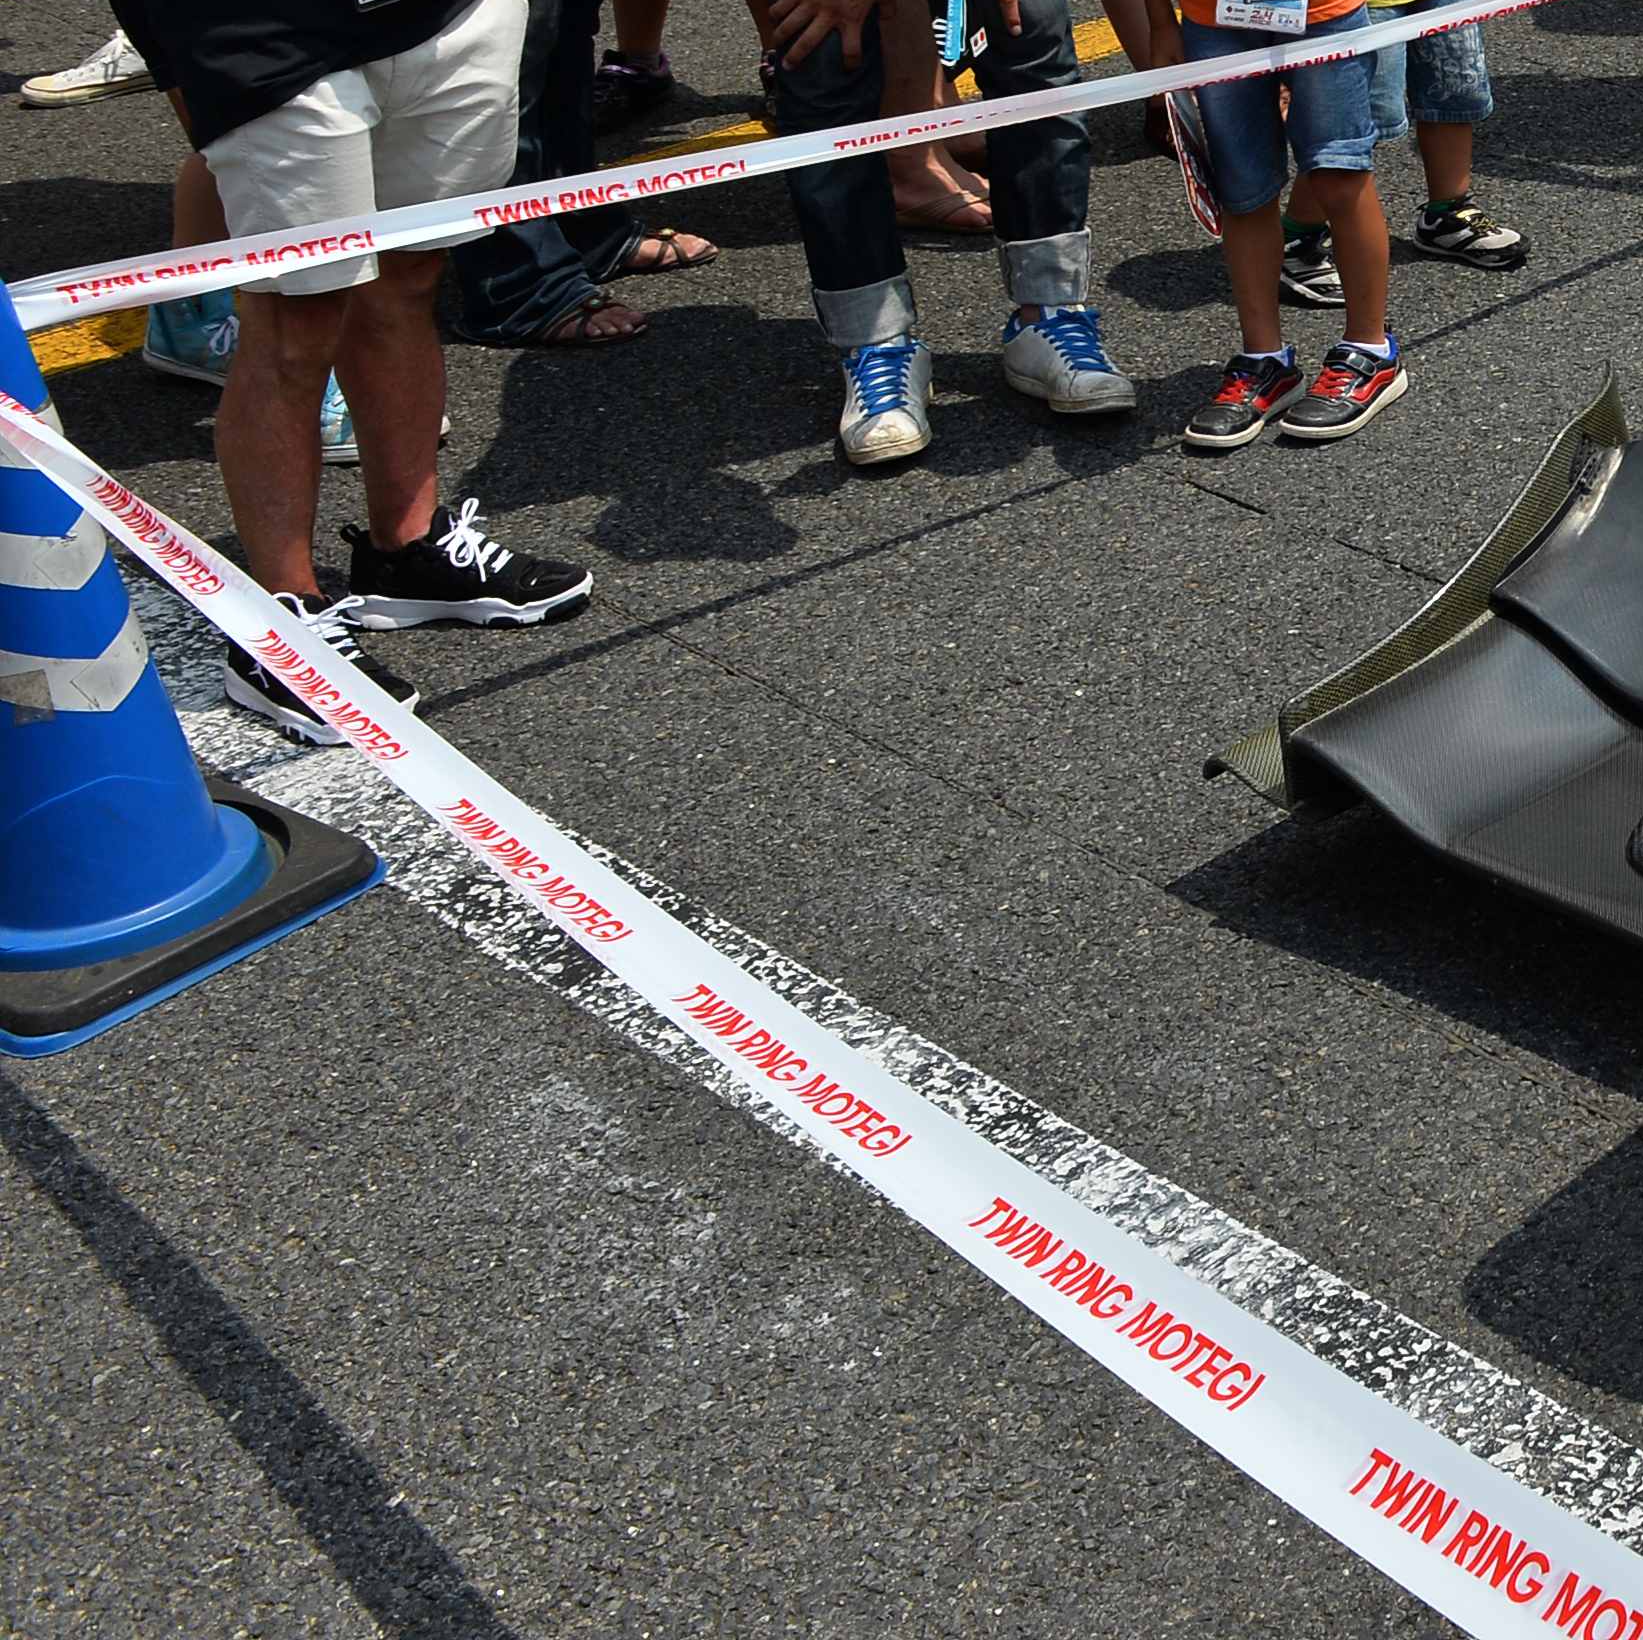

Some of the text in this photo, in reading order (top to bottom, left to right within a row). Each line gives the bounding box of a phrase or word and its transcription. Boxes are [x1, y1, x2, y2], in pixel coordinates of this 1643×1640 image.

[474, 195, 553, 229] TWIN
[253, 629, 410, 761] TWIN RING MOTEGI
[443, 798, 634, 943] TWIN RING MOTEGI
[675, 983, 913, 1158] TWIN RING MOTEGI
[969, 1197, 1267, 1412] TWIN RING MOTEGI
[1349, 1448, 1460, 1545] TWIN
[1441, 1509, 1550, 1605] RING
